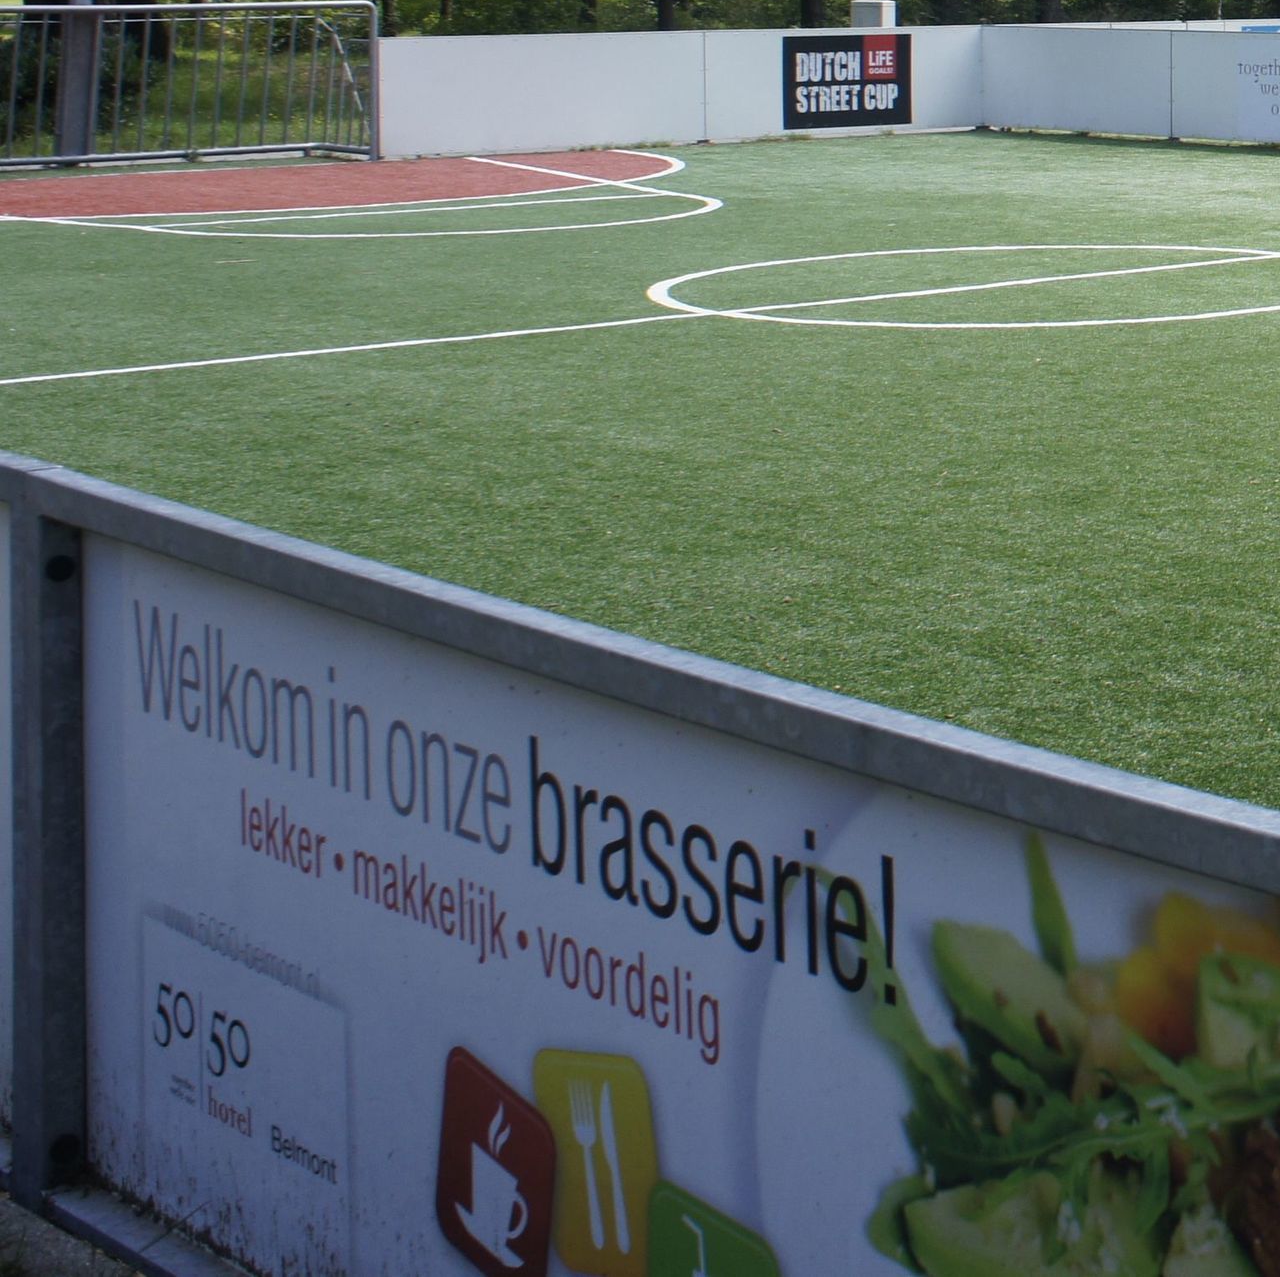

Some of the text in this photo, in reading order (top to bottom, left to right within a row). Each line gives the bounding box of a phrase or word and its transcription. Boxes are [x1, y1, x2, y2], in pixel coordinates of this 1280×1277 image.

[795, 51, 860, 82] DUTCH
[795, 83, 898, 113] STREET CUP
[134, 599, 897, 1006] Welkom in onze brasserie!
[241, 787, 719, 1065] lekker makkelijk voordelig
[153, 982, 252, 1077] 50 50
[207, 1085, 253, 1139] hotel
[270, 1124, 338, 1185] Belmont
